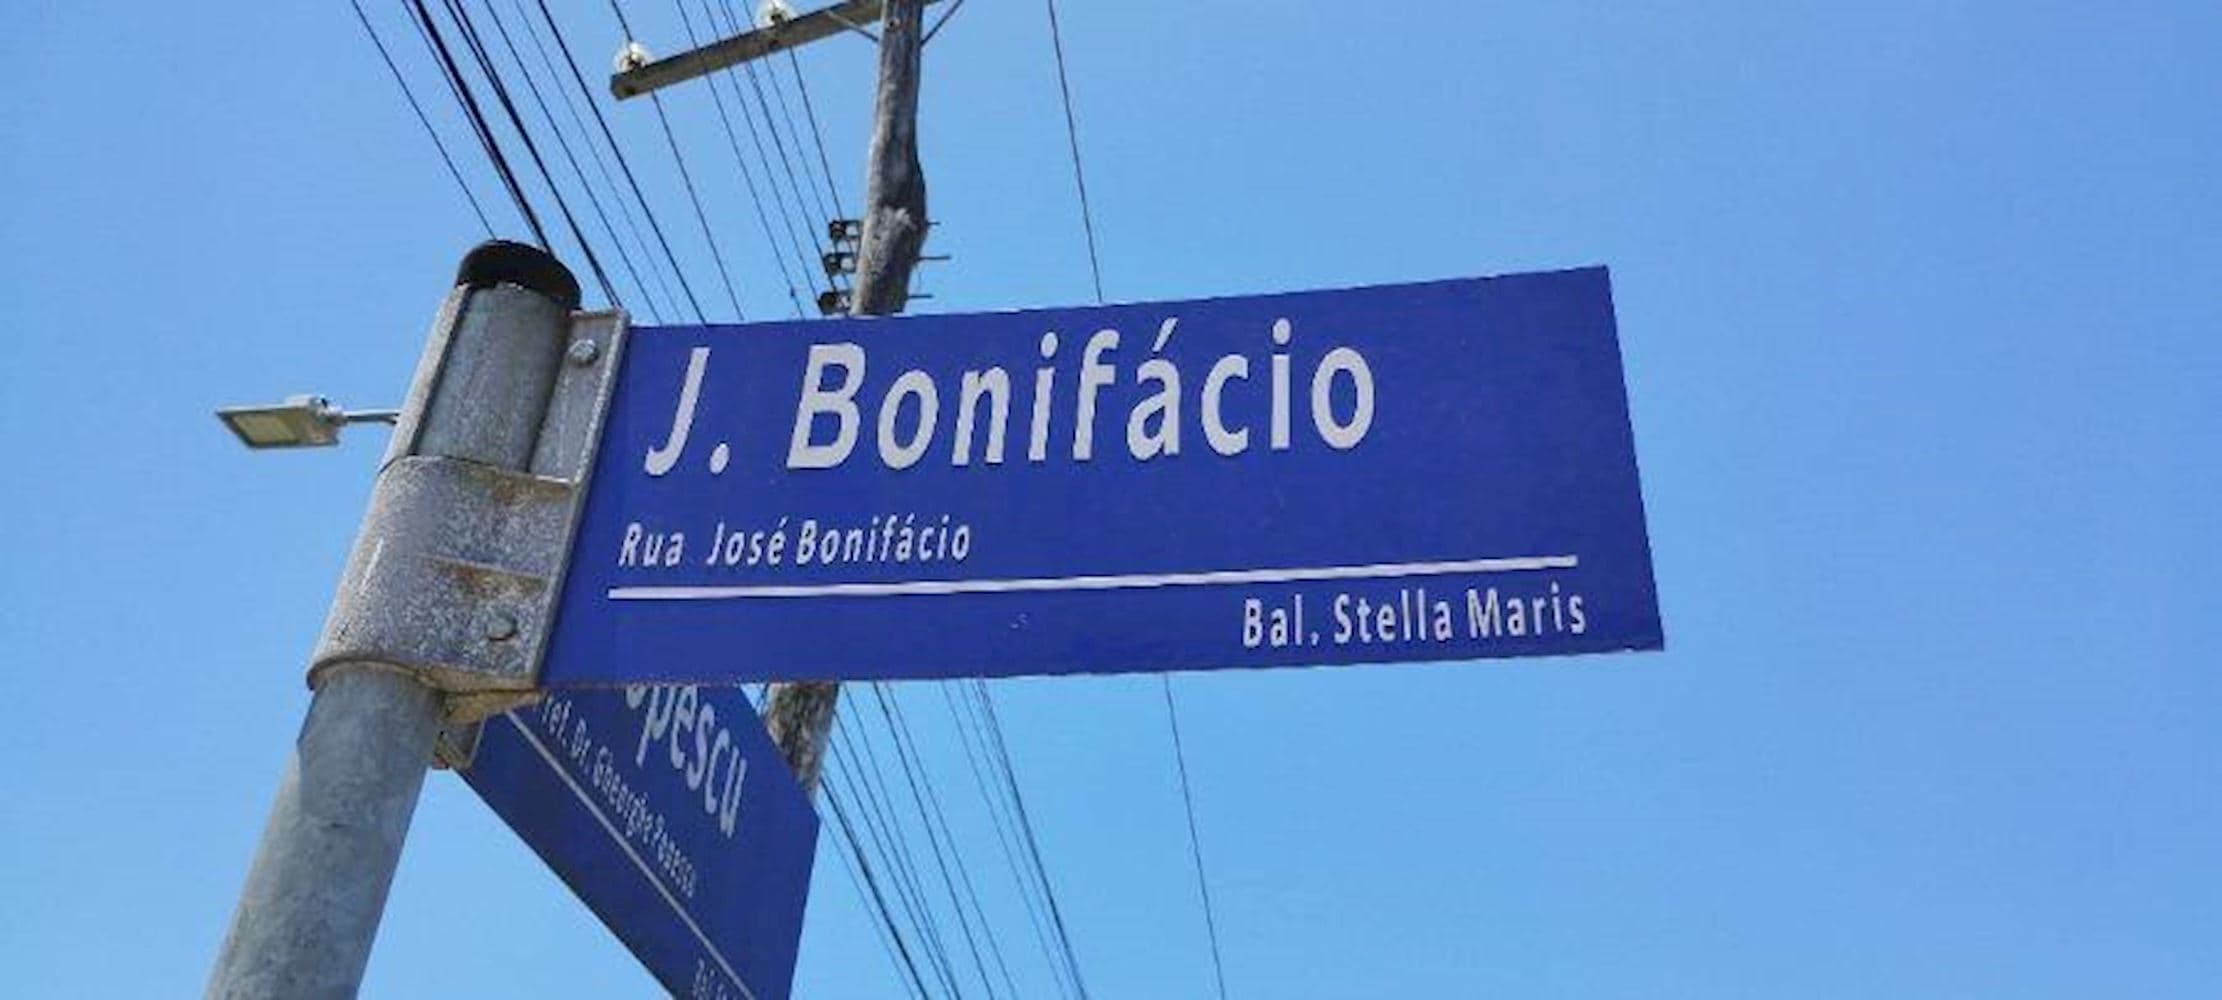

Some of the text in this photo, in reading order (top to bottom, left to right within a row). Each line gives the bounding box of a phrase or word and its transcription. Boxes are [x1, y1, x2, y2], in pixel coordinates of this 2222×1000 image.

[644, 318, 1375, 476] J. Bonifácio
[618, 513, 971, 567] Rua José Bonifácio
[1243, 581, 1587, 647] Bal. Stella Maris
